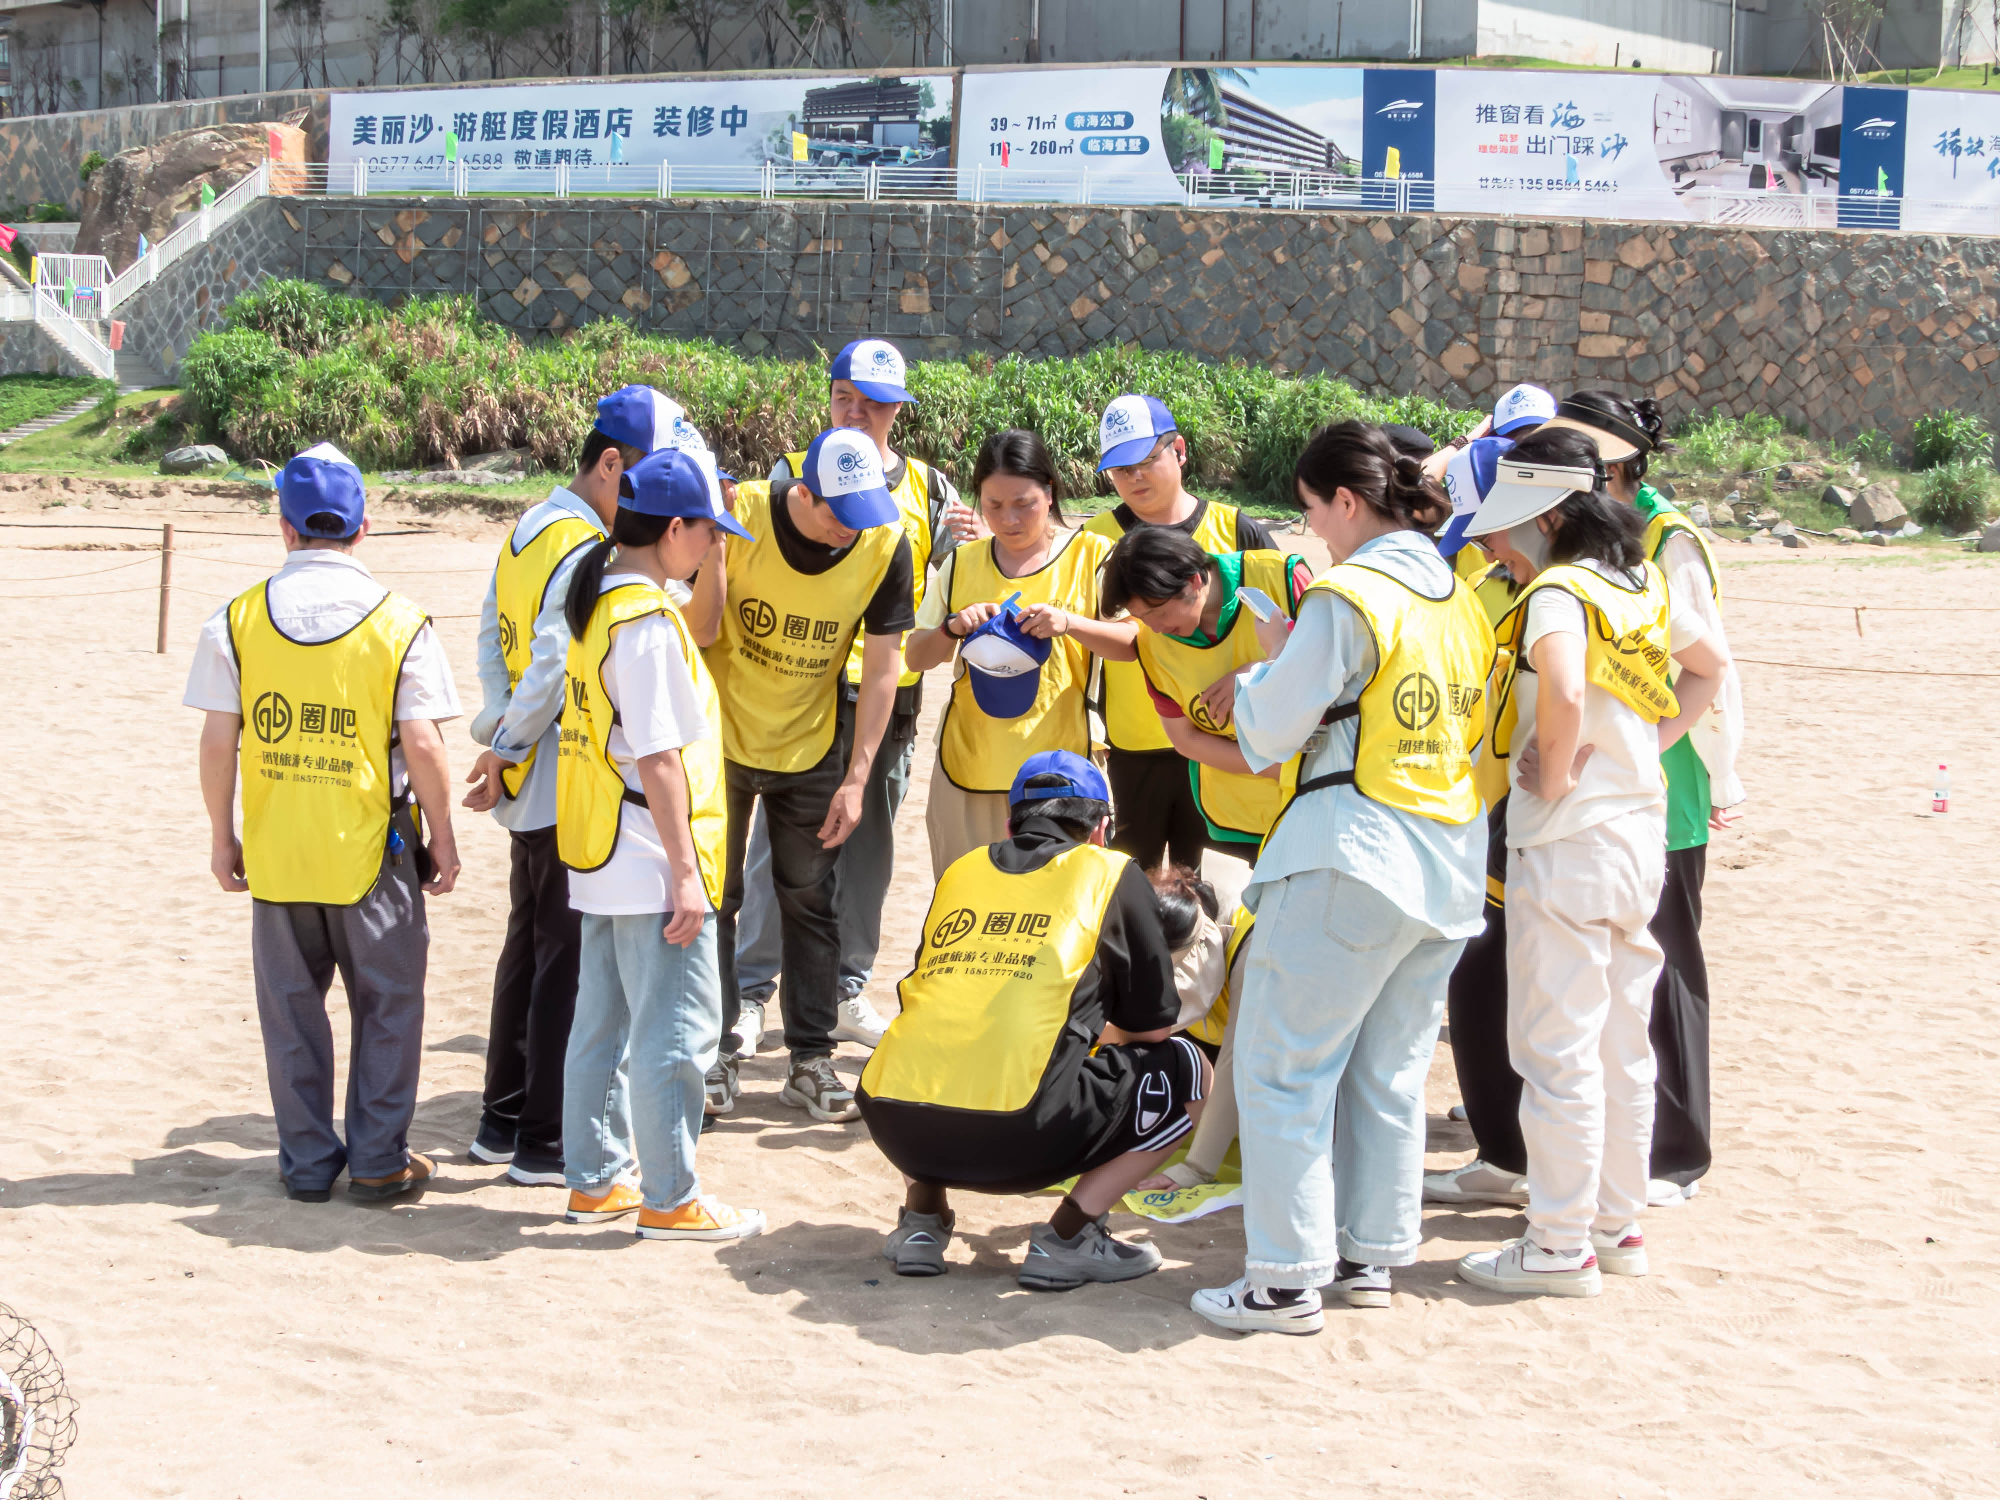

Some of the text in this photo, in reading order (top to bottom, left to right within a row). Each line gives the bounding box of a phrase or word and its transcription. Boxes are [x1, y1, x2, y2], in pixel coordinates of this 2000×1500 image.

[352, 99, 748, 145] 美丽沙·游艇度假酒店 装修中
[1475, 100, 1585, 131] 推窗看海
[1526, 133, 1628, 163] 出门踩沙
[368, 156, 409, 173] 0577
[782, 613, 839, 643] 圈吧
[781, 638, 836, 650] QUANBA
[299, 702, 356, 739] 圈吧
[981, 912, 1052, 938] 圈吧
[964, 967, 1033, 981] 15857777620
